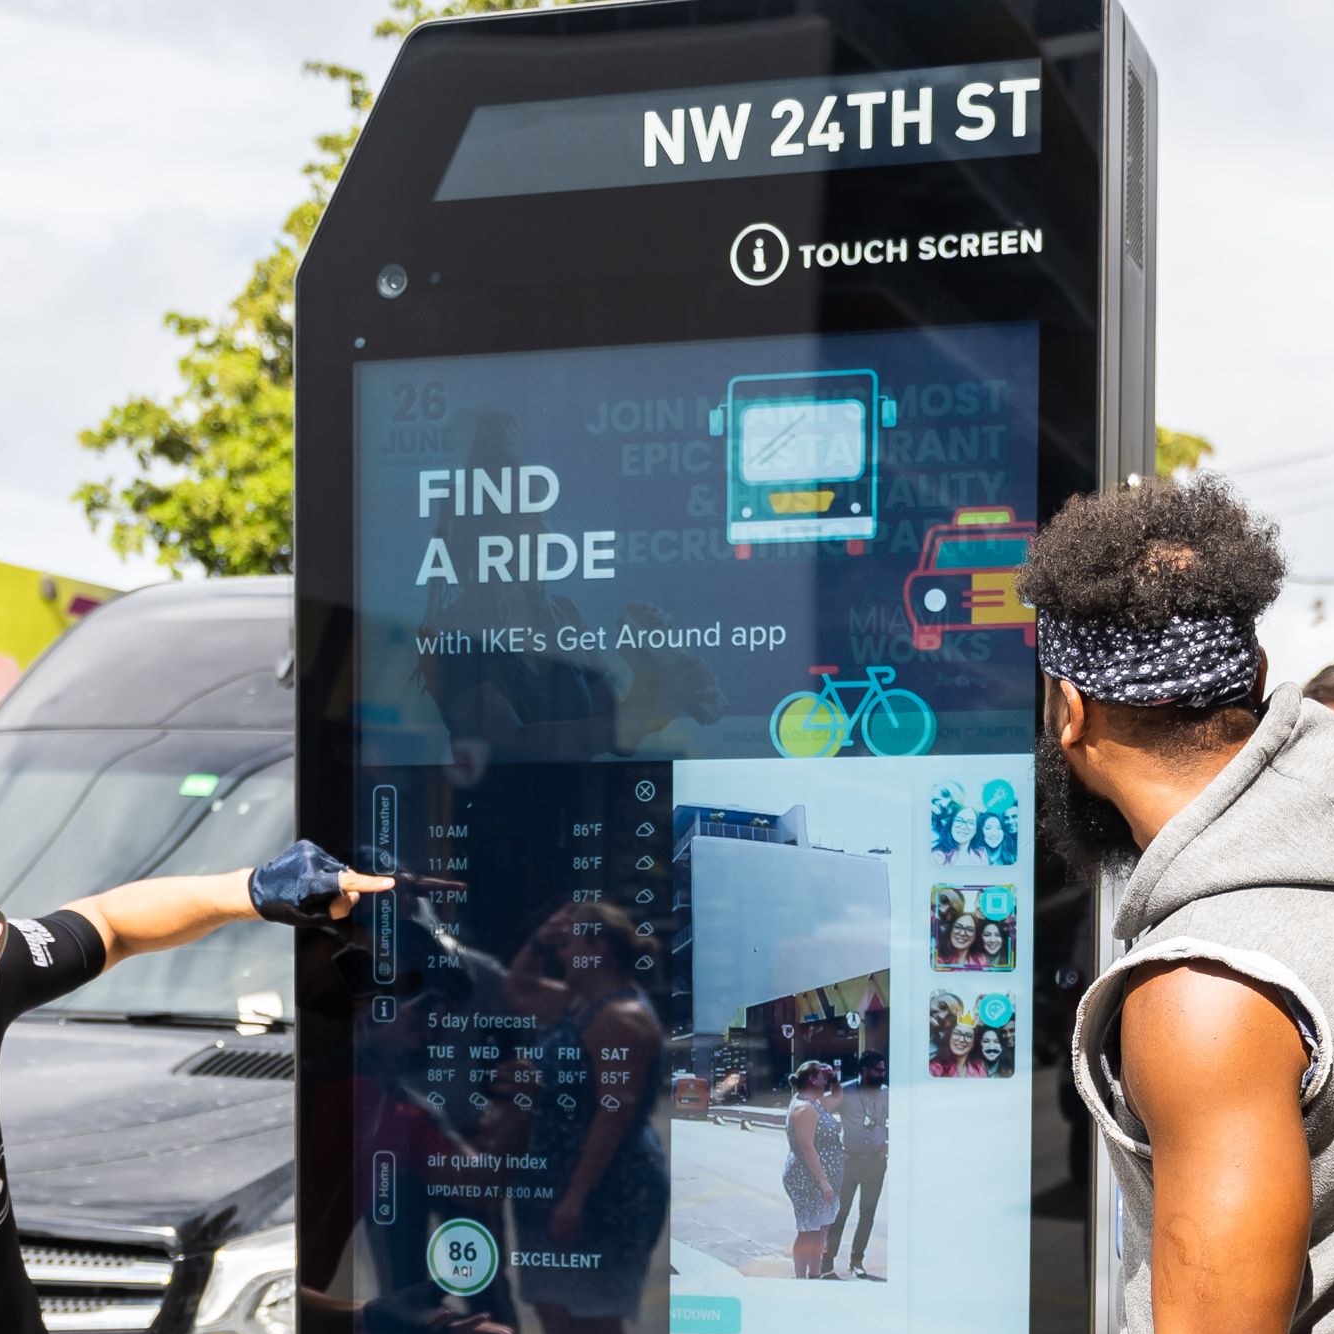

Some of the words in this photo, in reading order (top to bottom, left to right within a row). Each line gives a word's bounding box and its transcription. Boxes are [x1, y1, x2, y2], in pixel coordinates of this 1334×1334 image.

[643, 102, 752, 168] NW
[769, 86, 933, 158] 24TH
[954, 77, 1041, 142] ST
[798, 238, 907, 269] TOUCH
[917, 228, 1043, 261] SCREEN
[393, 381, 447, 422] 26
[585, 396, 681, 436] JOIN
[886, 378, 1009, 420] MOST
[380, 427, 457, 454] JUNE
[620, 439, 712, 478] EPIC
[419, 465, 560, 518] FIND
[686, 482, 716, 518] &
[415, 537, 459, 586] A
[478, 530, 616, 584] RIDE
[848, 604, 951, 635] MIAMI
[415, 629, 472, 655] with
[481, 627, 547, 653] IKE's
[556, 625, 607, 651] Get
[615, 621, 721, 649] Around
[731, 625, 787, 652] app
[849, 631, 992, 665] WORKS
[378, 796, 390, 846] Weather
[428, 825, 444, 838] 10
[447, 825, 468, 838] AM
[573, 823, 603, 837] 86°F
[428, 858, 443, 871] 11
[447, 858, 468, 871] AM
[573, 856, 603, 870] 86°F
[428, 890, 444, 904] 12
[447, 890, 468, 904] PM
[573, 889, 603, 903] 87°F
[380, 898, 392, 957] Language
[573, 922, 603, 936] 87°F
[427, 956, 436, 969] 2
[439, 956, 460, 969] PM
[573, 955, 603, 969] 88°F
[427, 1012, 437, 1028] 5
[442, 1012, 469, 1031] day
[473, 1012, 538, 1030] forecast
[427, 1045, 455, 1059] TUE
[468, 1046, 500, 1060] WED
[514, 1047, 544, 1060] THU
[557, 1048, 581, 1061] FRI
[600, 1048, 630, 1061] SAT
[427, 1153, 447, 1168] air
[451, 1153, 502, 1173] quality
[506, 1153, 548, 1170] index
[378, 1161, 389, 1198] Home
[427, 1185, 481, 1198] UPDATED
[484, 1186, 503, 1198] AT:
[506, 1186, 531, 1199] 8:00
[534, 1187, 553, 1199] AM
[448, 1241, 477, 1262] 86
[510, 1251, 602, 1269] EXCELLENT
